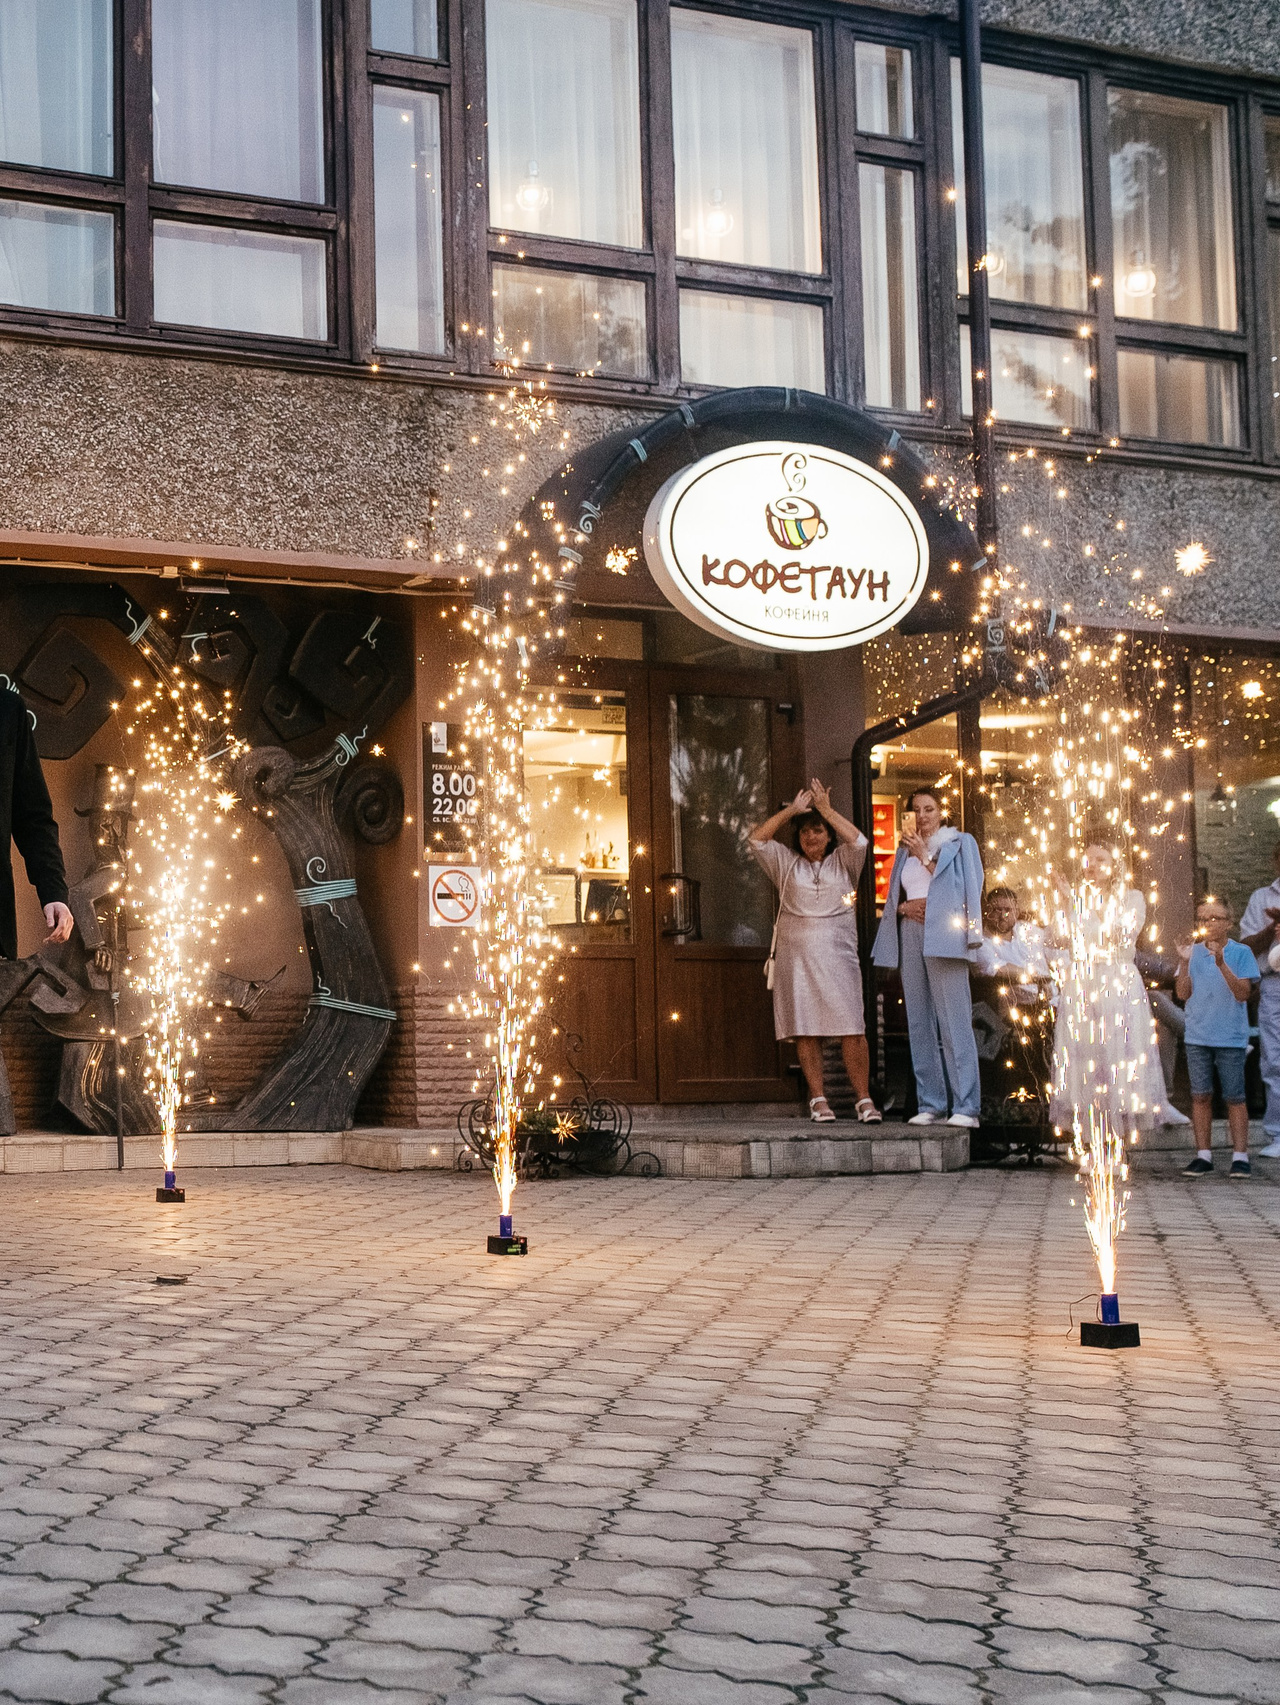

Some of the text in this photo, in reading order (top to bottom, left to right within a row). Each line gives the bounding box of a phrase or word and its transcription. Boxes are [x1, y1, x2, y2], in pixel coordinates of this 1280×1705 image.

[701, 554, 891, 602] КОФЕТАУН
[764, 605, 830, 623] КОФЕЙНЯ
[432, 773, 476, 796] 8.00
